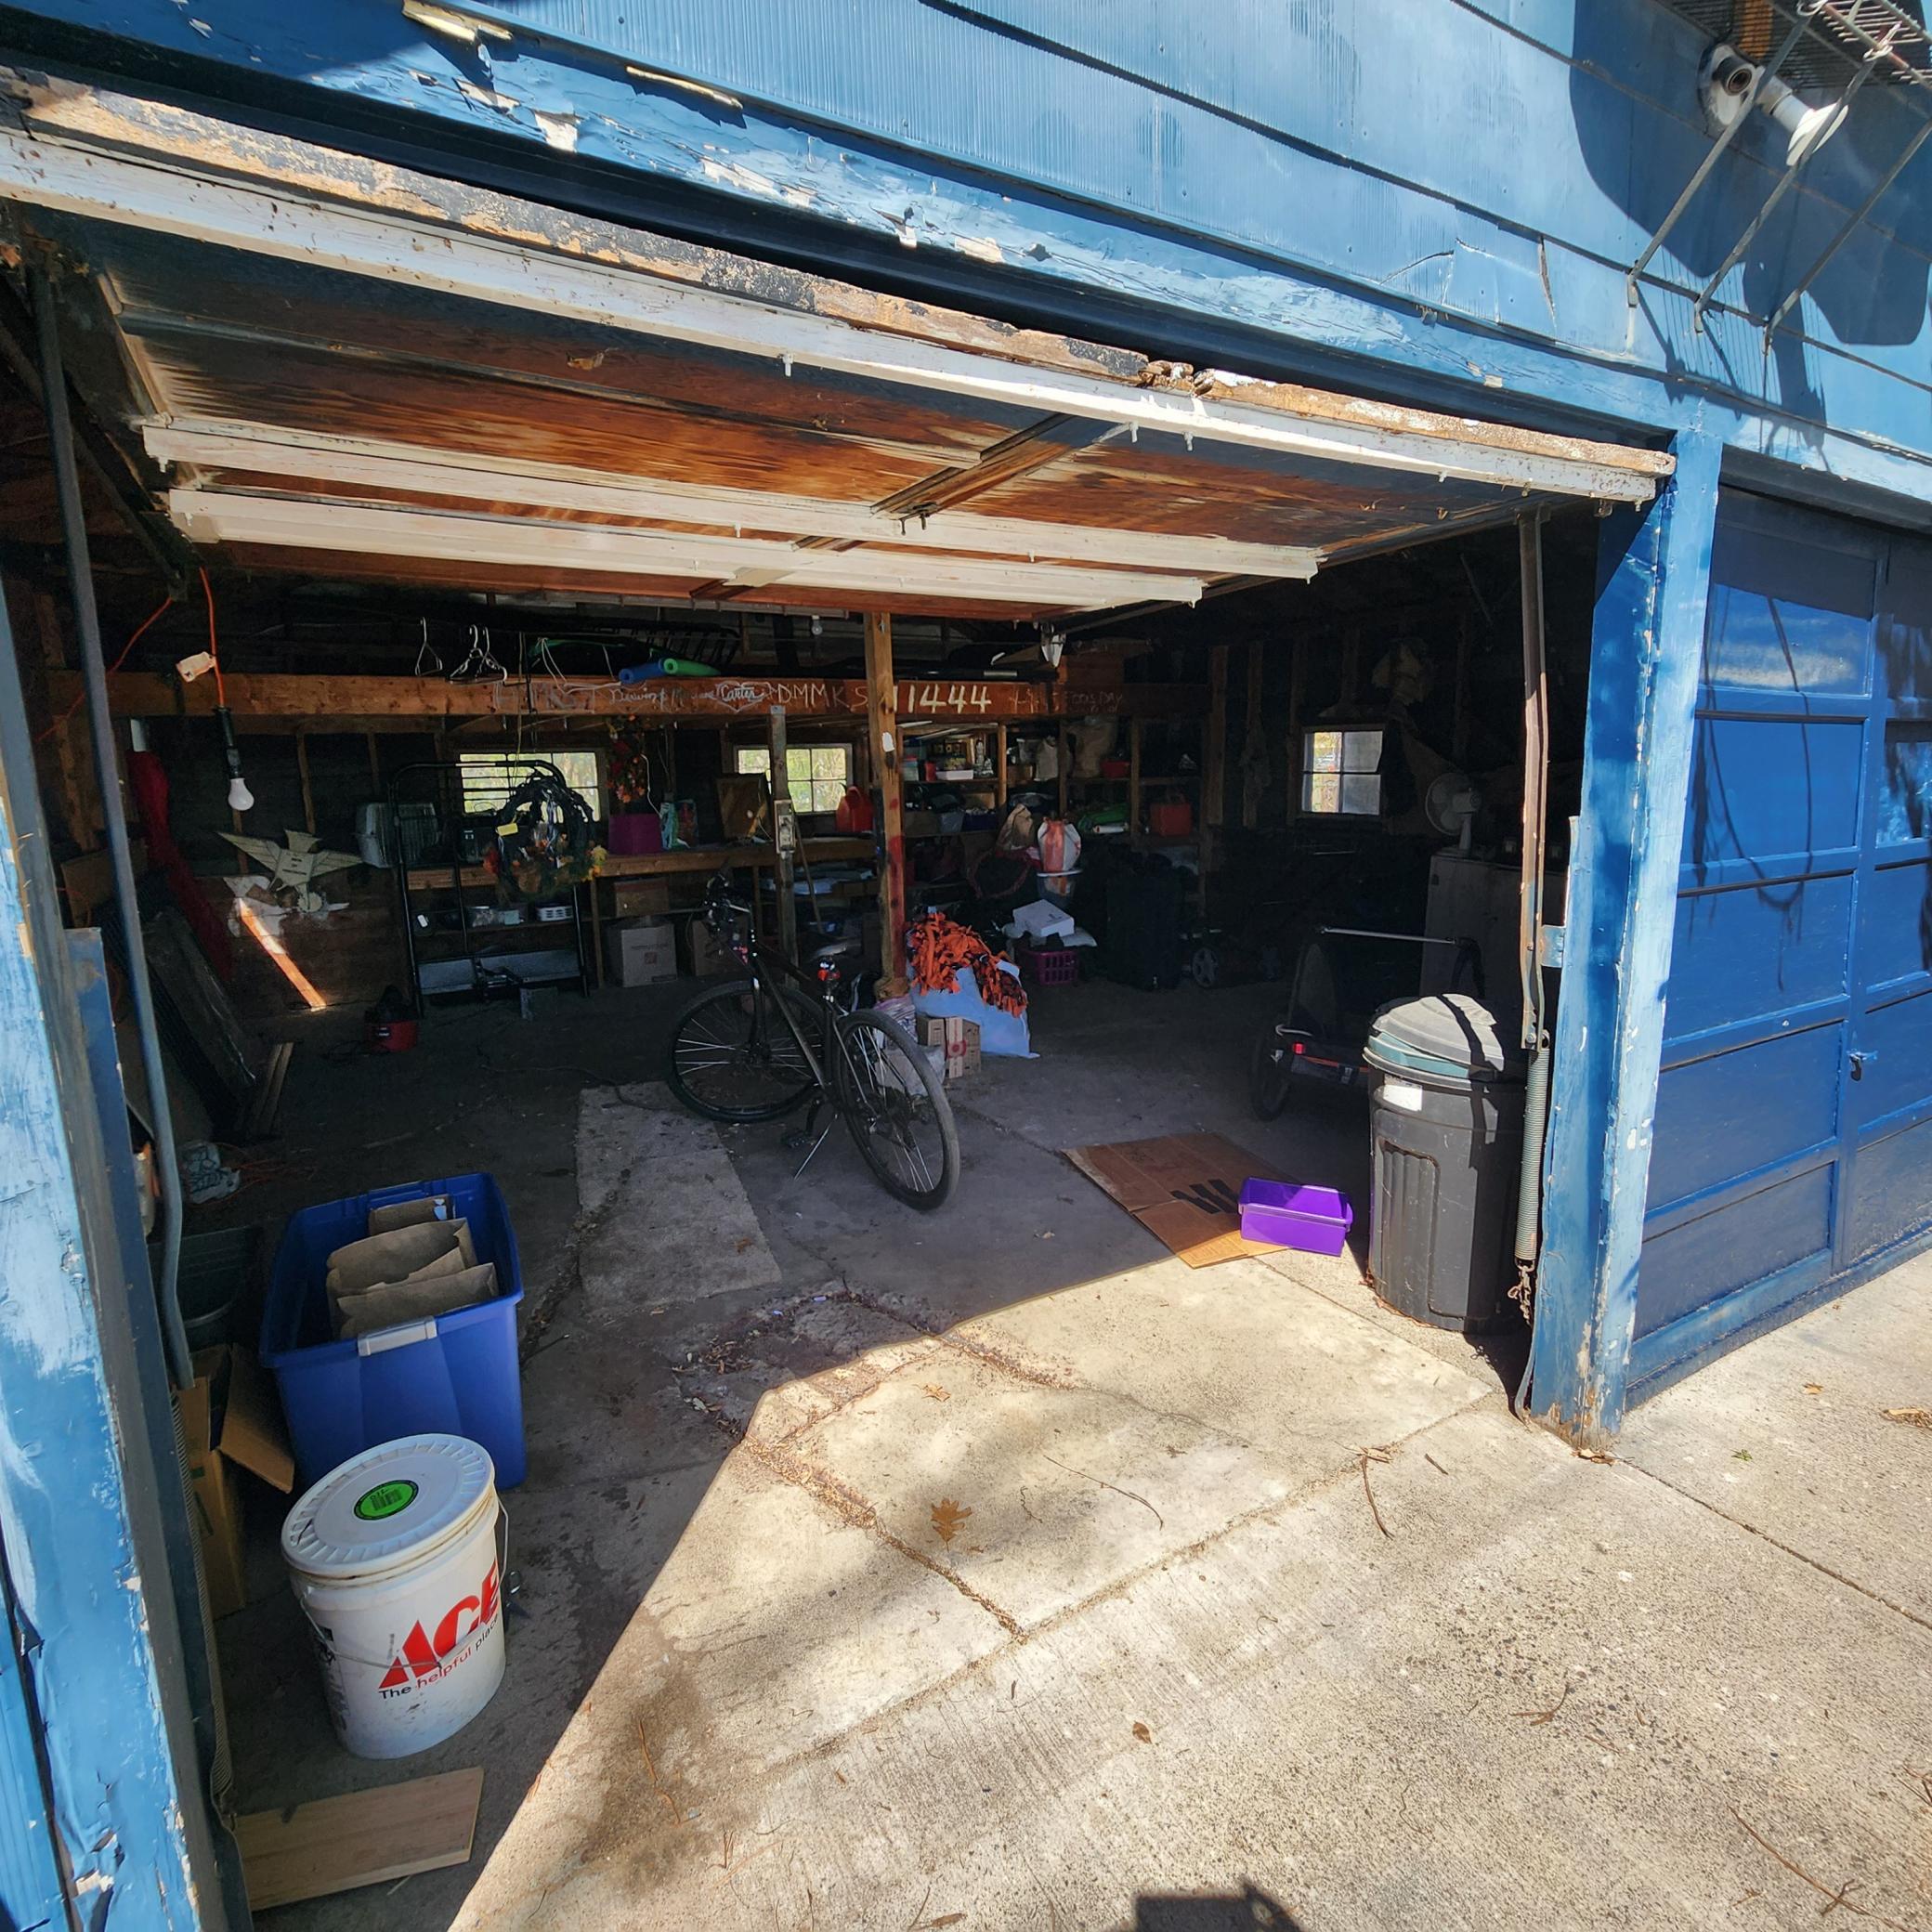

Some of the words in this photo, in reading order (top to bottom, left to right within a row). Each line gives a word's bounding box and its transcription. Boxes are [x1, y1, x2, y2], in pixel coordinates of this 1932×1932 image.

[378, 1559, 499, 1689] ACE
[378, 1686, 411, 1700] The
[417, 1645, 472, 1689] helpful
